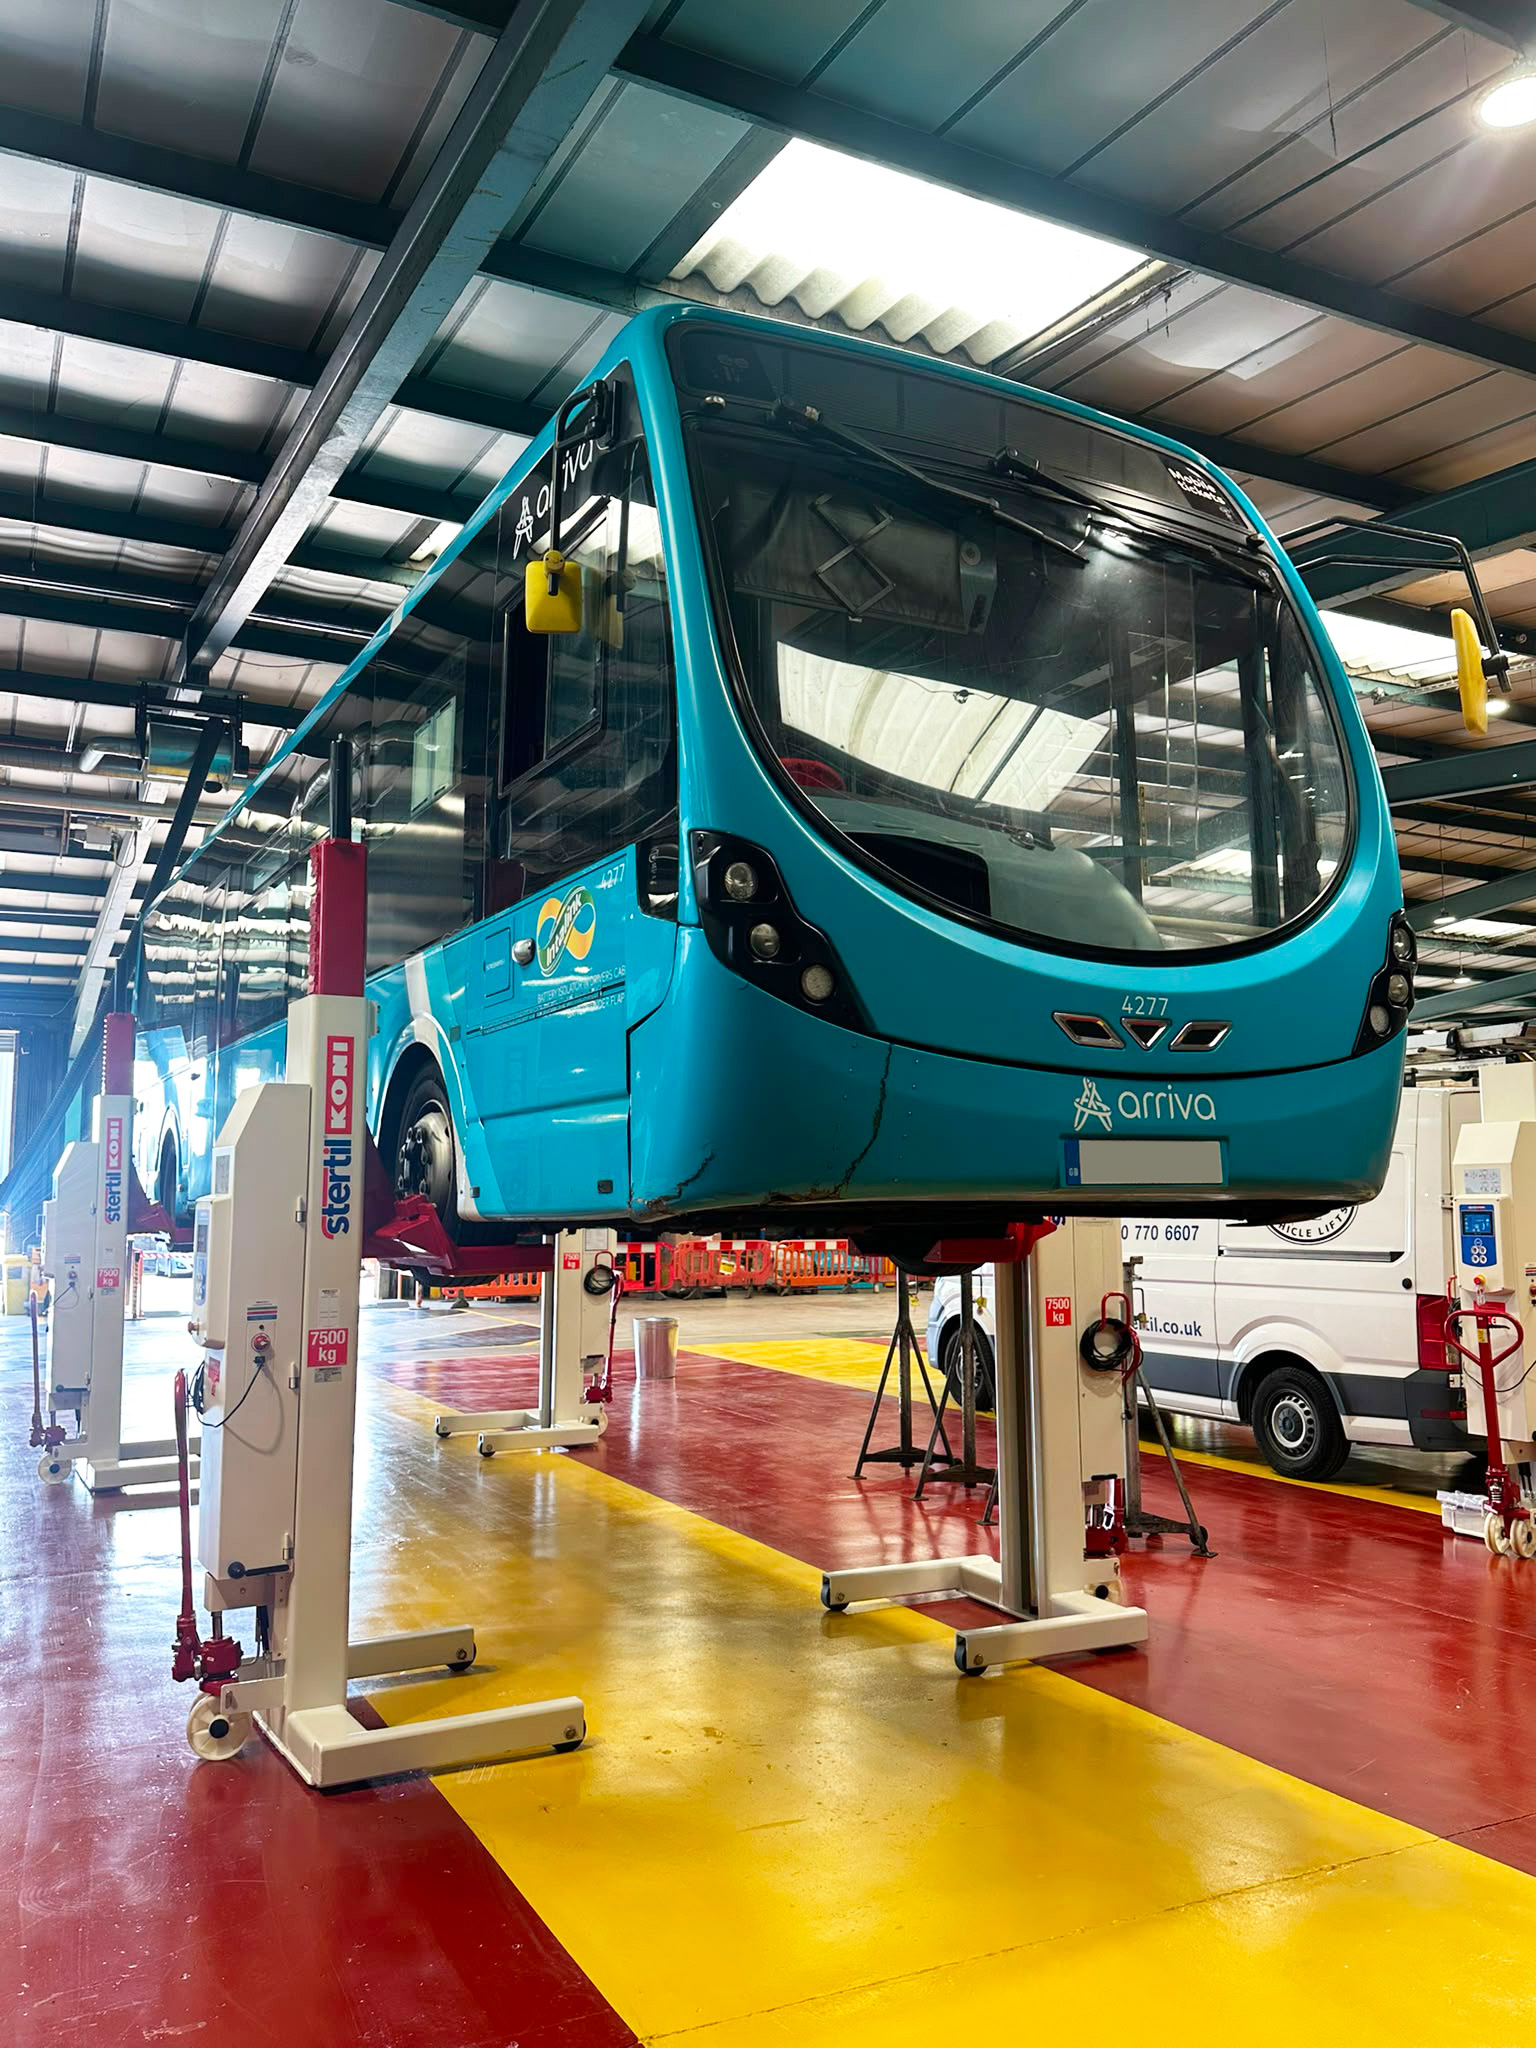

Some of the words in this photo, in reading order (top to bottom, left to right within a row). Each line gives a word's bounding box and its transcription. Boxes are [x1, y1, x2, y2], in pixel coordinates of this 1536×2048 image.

[1167, 467, 1217, 494] Mobile
[1177, 480, 1226, 505] tickets
[600, 863, 625, 890] 4277
[546, 892, 583, 967] Intalink
[613, 964, 626, 978] CAB
[1121, 995, 1169, 1016] 4277
[329, 1041, 350, 1130] KONI
[1117, 1084, 1217, 1121] arriva
[108, 1119, 121, 1169] KONI
[1068, 1167, 1079, 1177] GB
[106, 1172, 122, 1223] stertil
[322, 1139, 352, 1238] stertil
[1318, 1206, 1348, 1236] LIFTS
[1135, 1225, 1159, 1240] 770
[1165, 1225, 1199, 1241] 6607
[564, 1253, 579, 1261] 7500
[567, 1260, 576, 1269] kg
[98, 1269, 118, 1278] 7500
[102, 1278, 114, 1287] kg
[1046, 1298, 1070, 1310] 7500
[1052, 1310, 1065, 1325] kg
[310, 1329, 346, 1346] 7500
[319, 1346, 337, 1364] kg
